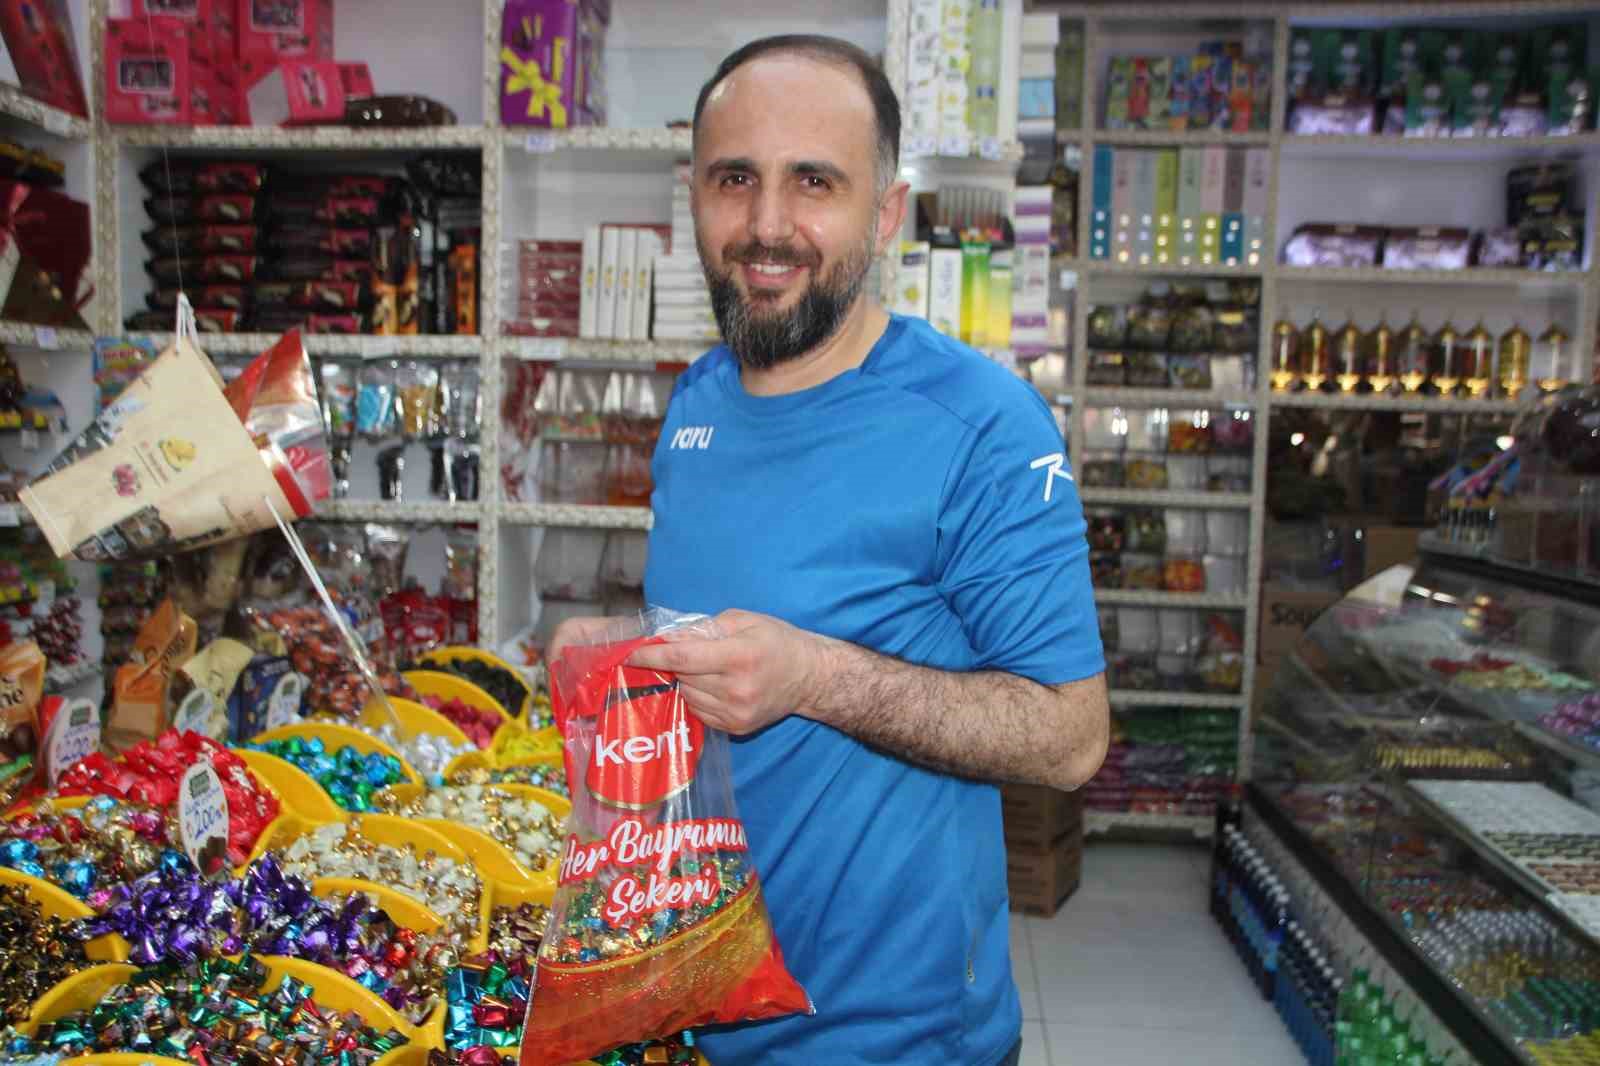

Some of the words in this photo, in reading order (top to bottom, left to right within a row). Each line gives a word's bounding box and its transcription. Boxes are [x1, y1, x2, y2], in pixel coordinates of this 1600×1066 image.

[595, 719, 693, 767] kent
[559, 838, 609, 881] Her
[607, 867, 716, 923] Şekeri
